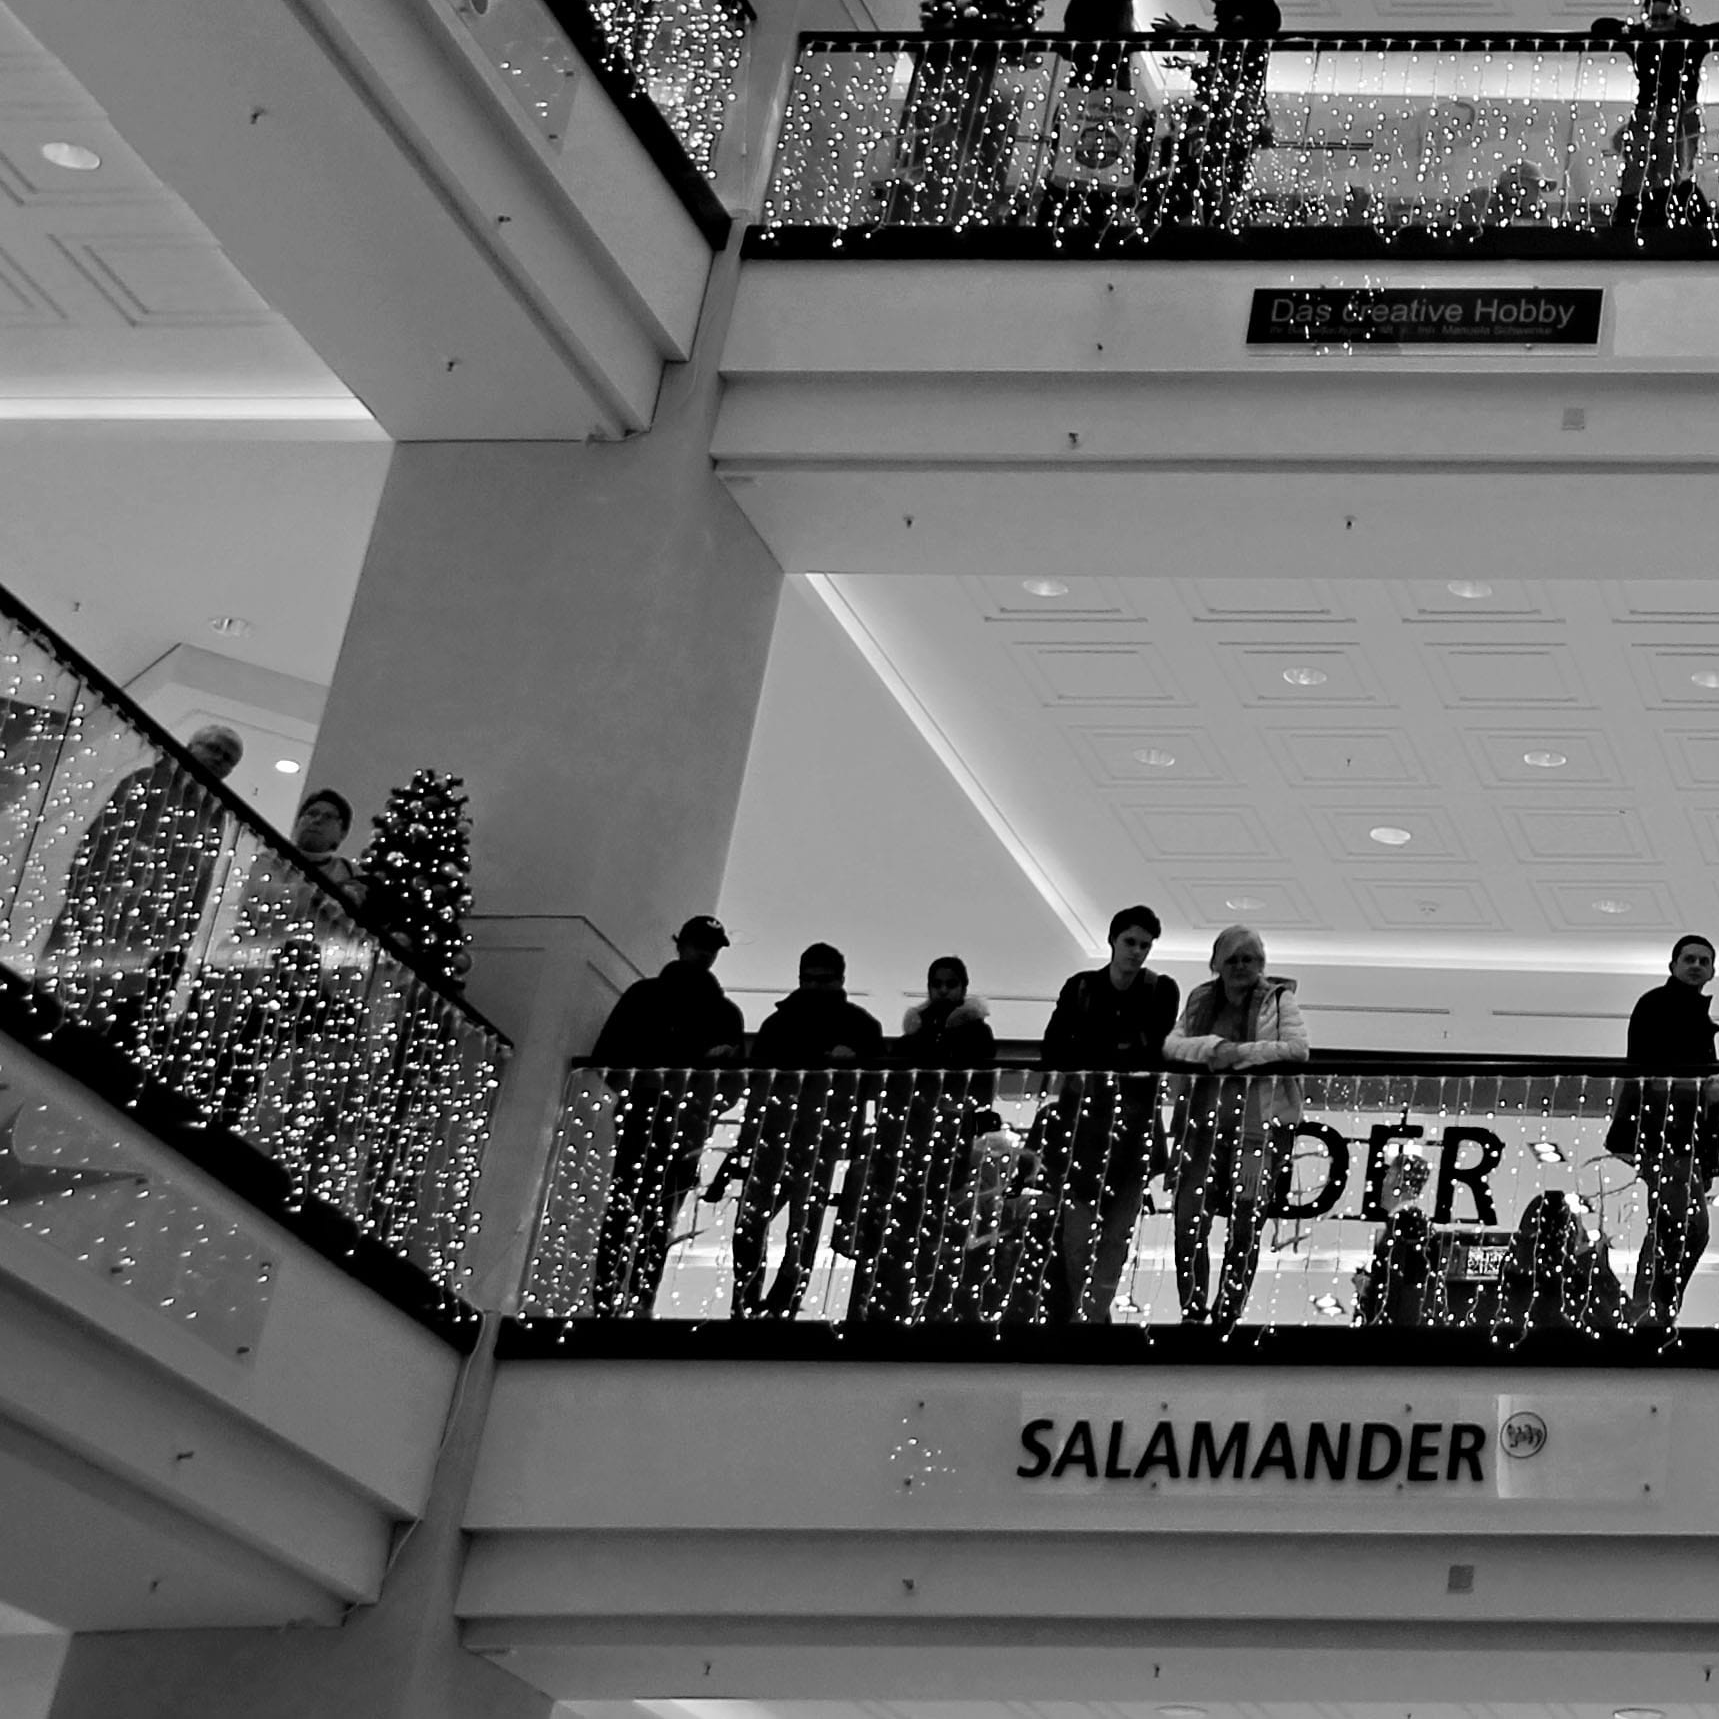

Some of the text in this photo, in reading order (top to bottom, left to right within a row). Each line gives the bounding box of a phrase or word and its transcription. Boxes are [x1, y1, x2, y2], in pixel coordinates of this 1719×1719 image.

[1271, 298, 1576, 329] Das creative Hobby
[1016, 1419, 1486, 1481] SALAMANDER
